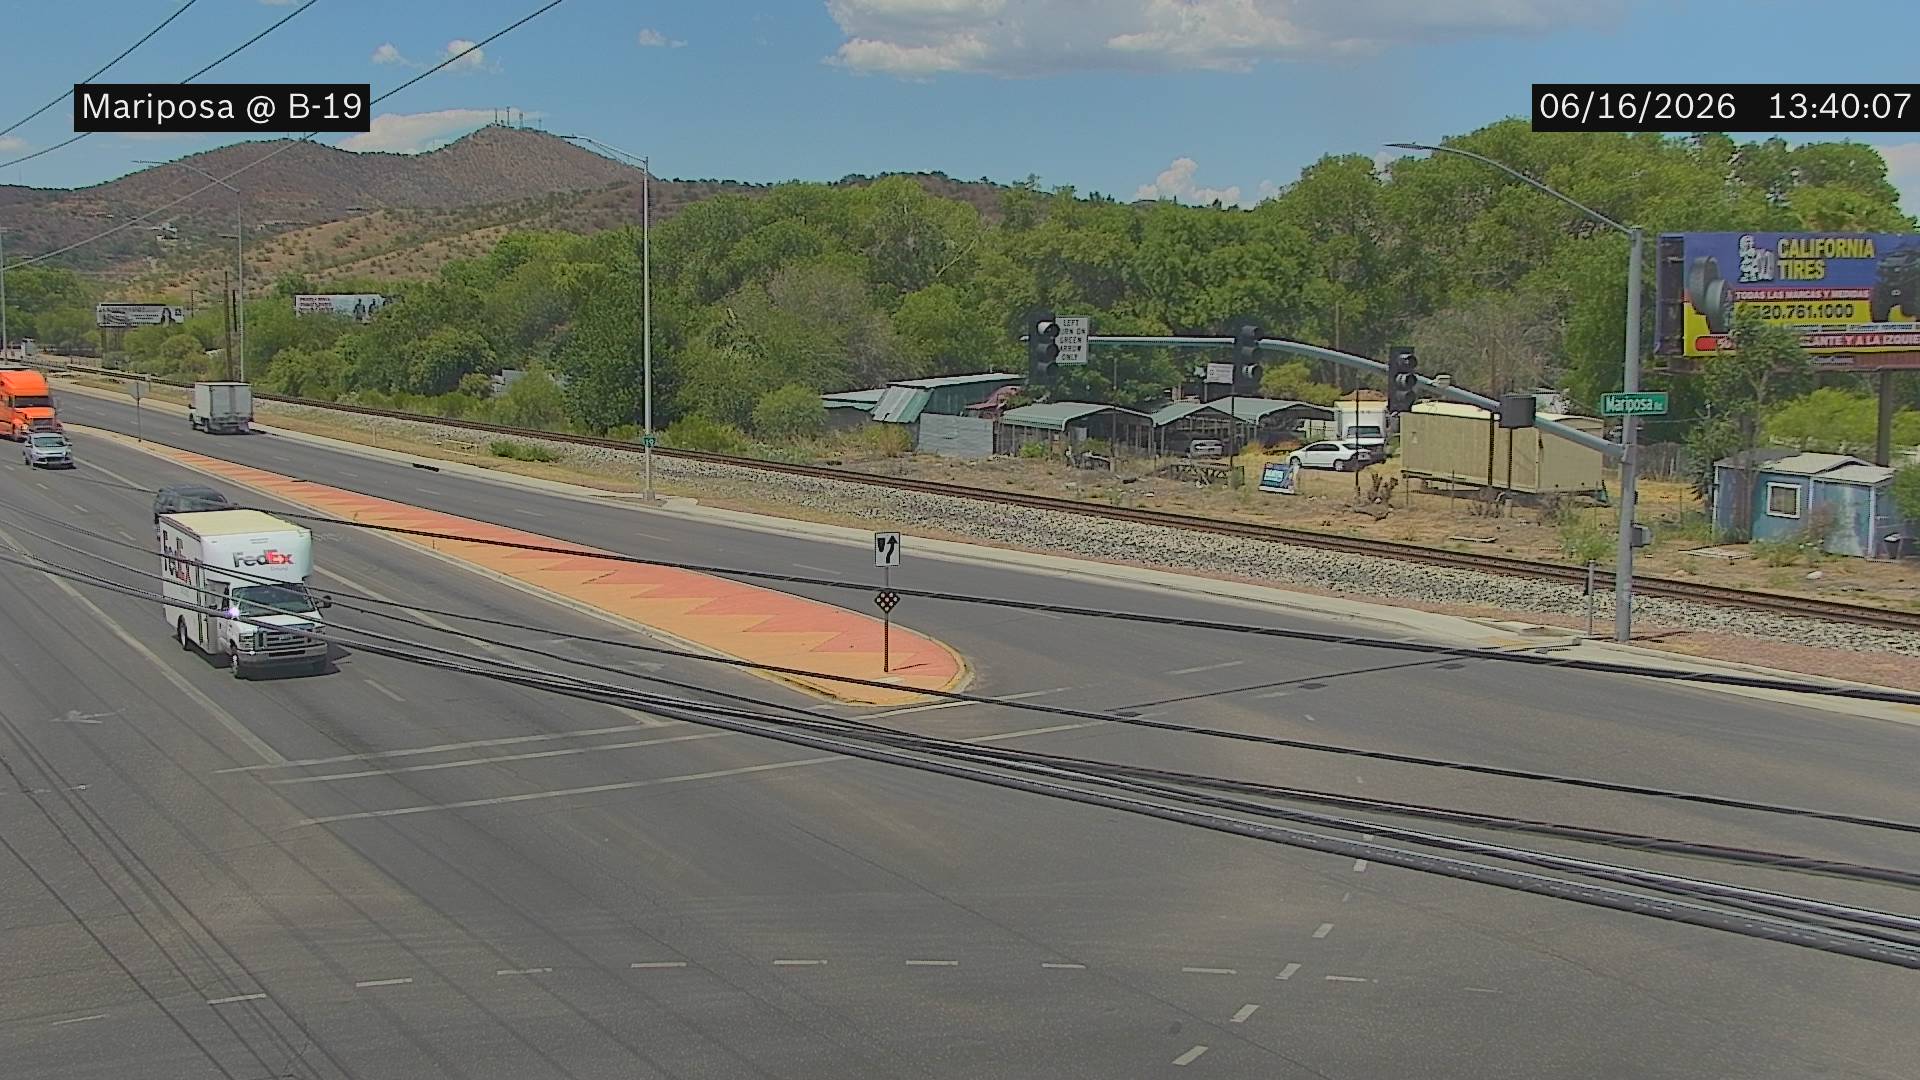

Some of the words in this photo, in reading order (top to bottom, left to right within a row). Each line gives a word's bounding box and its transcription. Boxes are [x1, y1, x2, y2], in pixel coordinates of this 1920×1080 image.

[1777, 238, 1875, 259] CALIFORNIA
[1777, 259, 1826, 280] TIRES
[1766, 290, 1785, 299] LAS
[1063, 319, 1079, 327] LEFT
[1061, 353, 1078, 361] ONLY
[1605, 396, 1653, 413] Mariposa
[232, 549, 295, 568] FedEx
